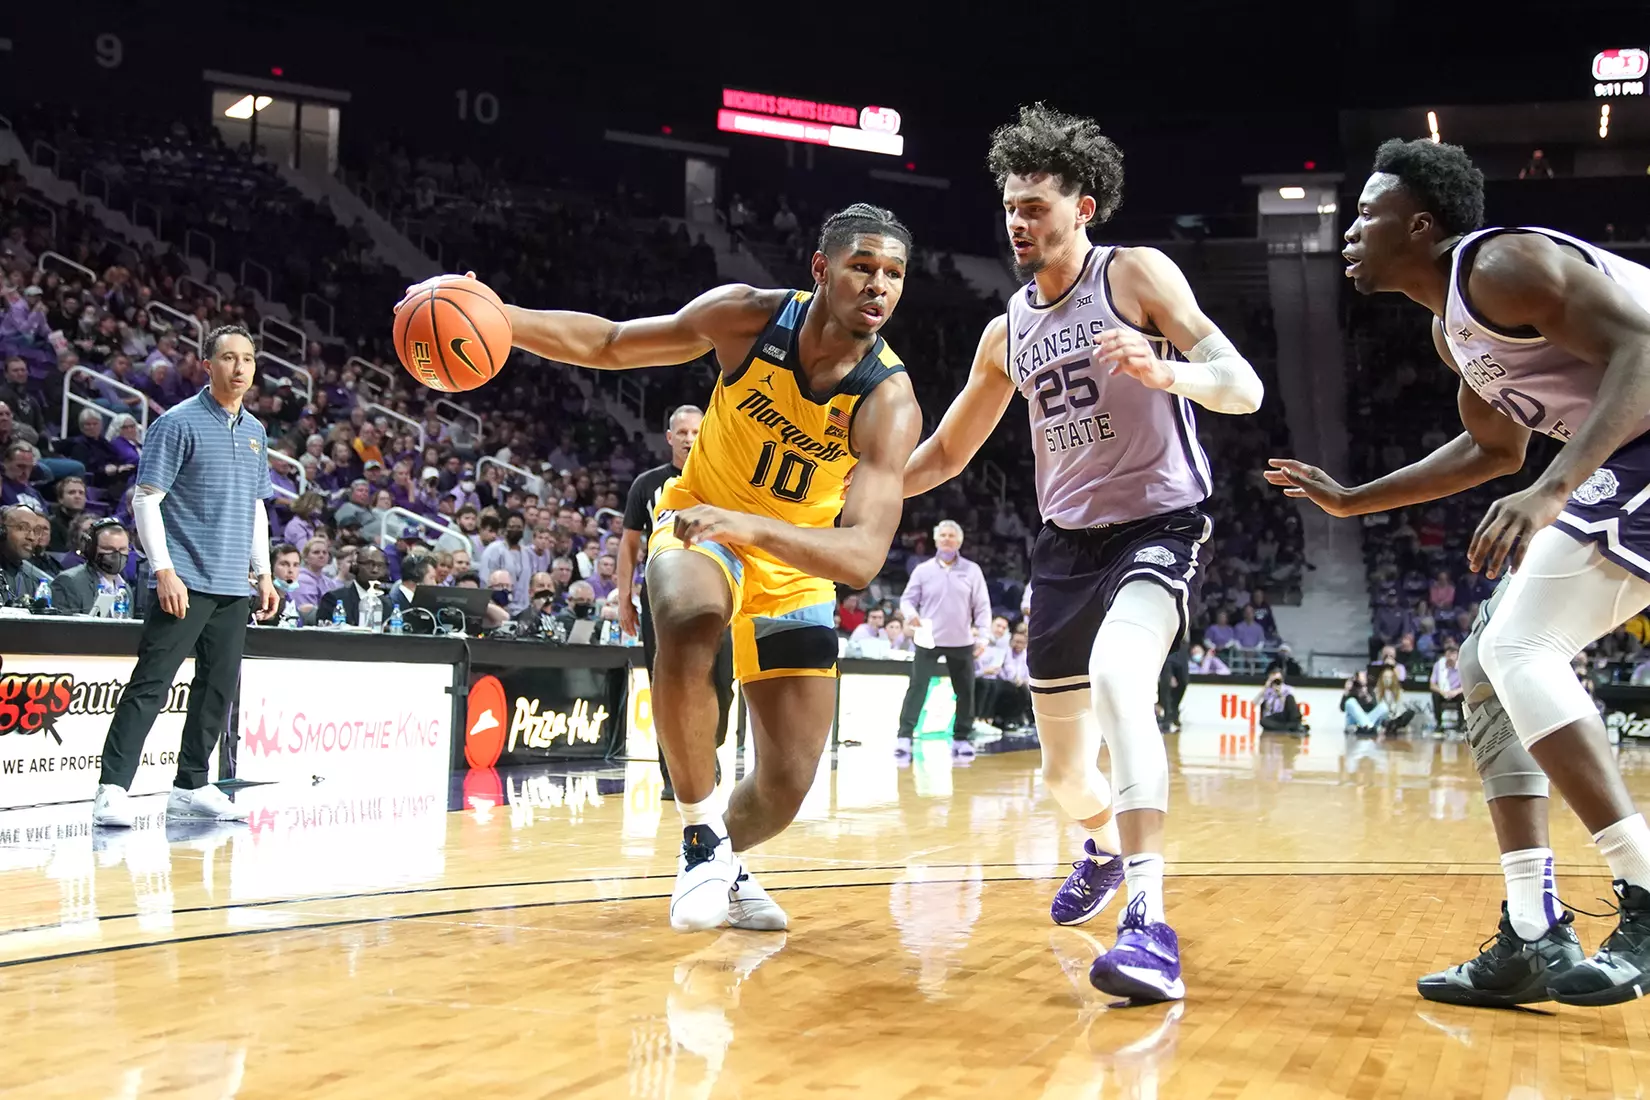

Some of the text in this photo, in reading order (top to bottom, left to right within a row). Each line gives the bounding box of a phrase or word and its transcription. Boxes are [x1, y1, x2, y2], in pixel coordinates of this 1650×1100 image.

[95, 33, 122, 68] 9
[455, 88, 499, 124] 10
[1622, 81, 1643, 96] PM
[776, 97, 817, 120] SPORTS
[817, 103, 857, 126] LEADER
[414, 340, 449, 391] ELITE
[1015, 319, 1106, 384] KANSAS
[1034, 358, 1100, 419] 25
[735, 388, 848, 463] Marquette
[1044, 413, 1117, 453] STATE
[748, 440, 819, 503] 10
[288, 711, 440, 754] SMOOTHIE KING
[507, 696, 567, 753] Pizza
[566, 698, 610, 746] Hut
[3, 759, 25, 775] WE
[29, 756, 56, 773] ARE
[60, 752, 156, 771] PROFEAL
